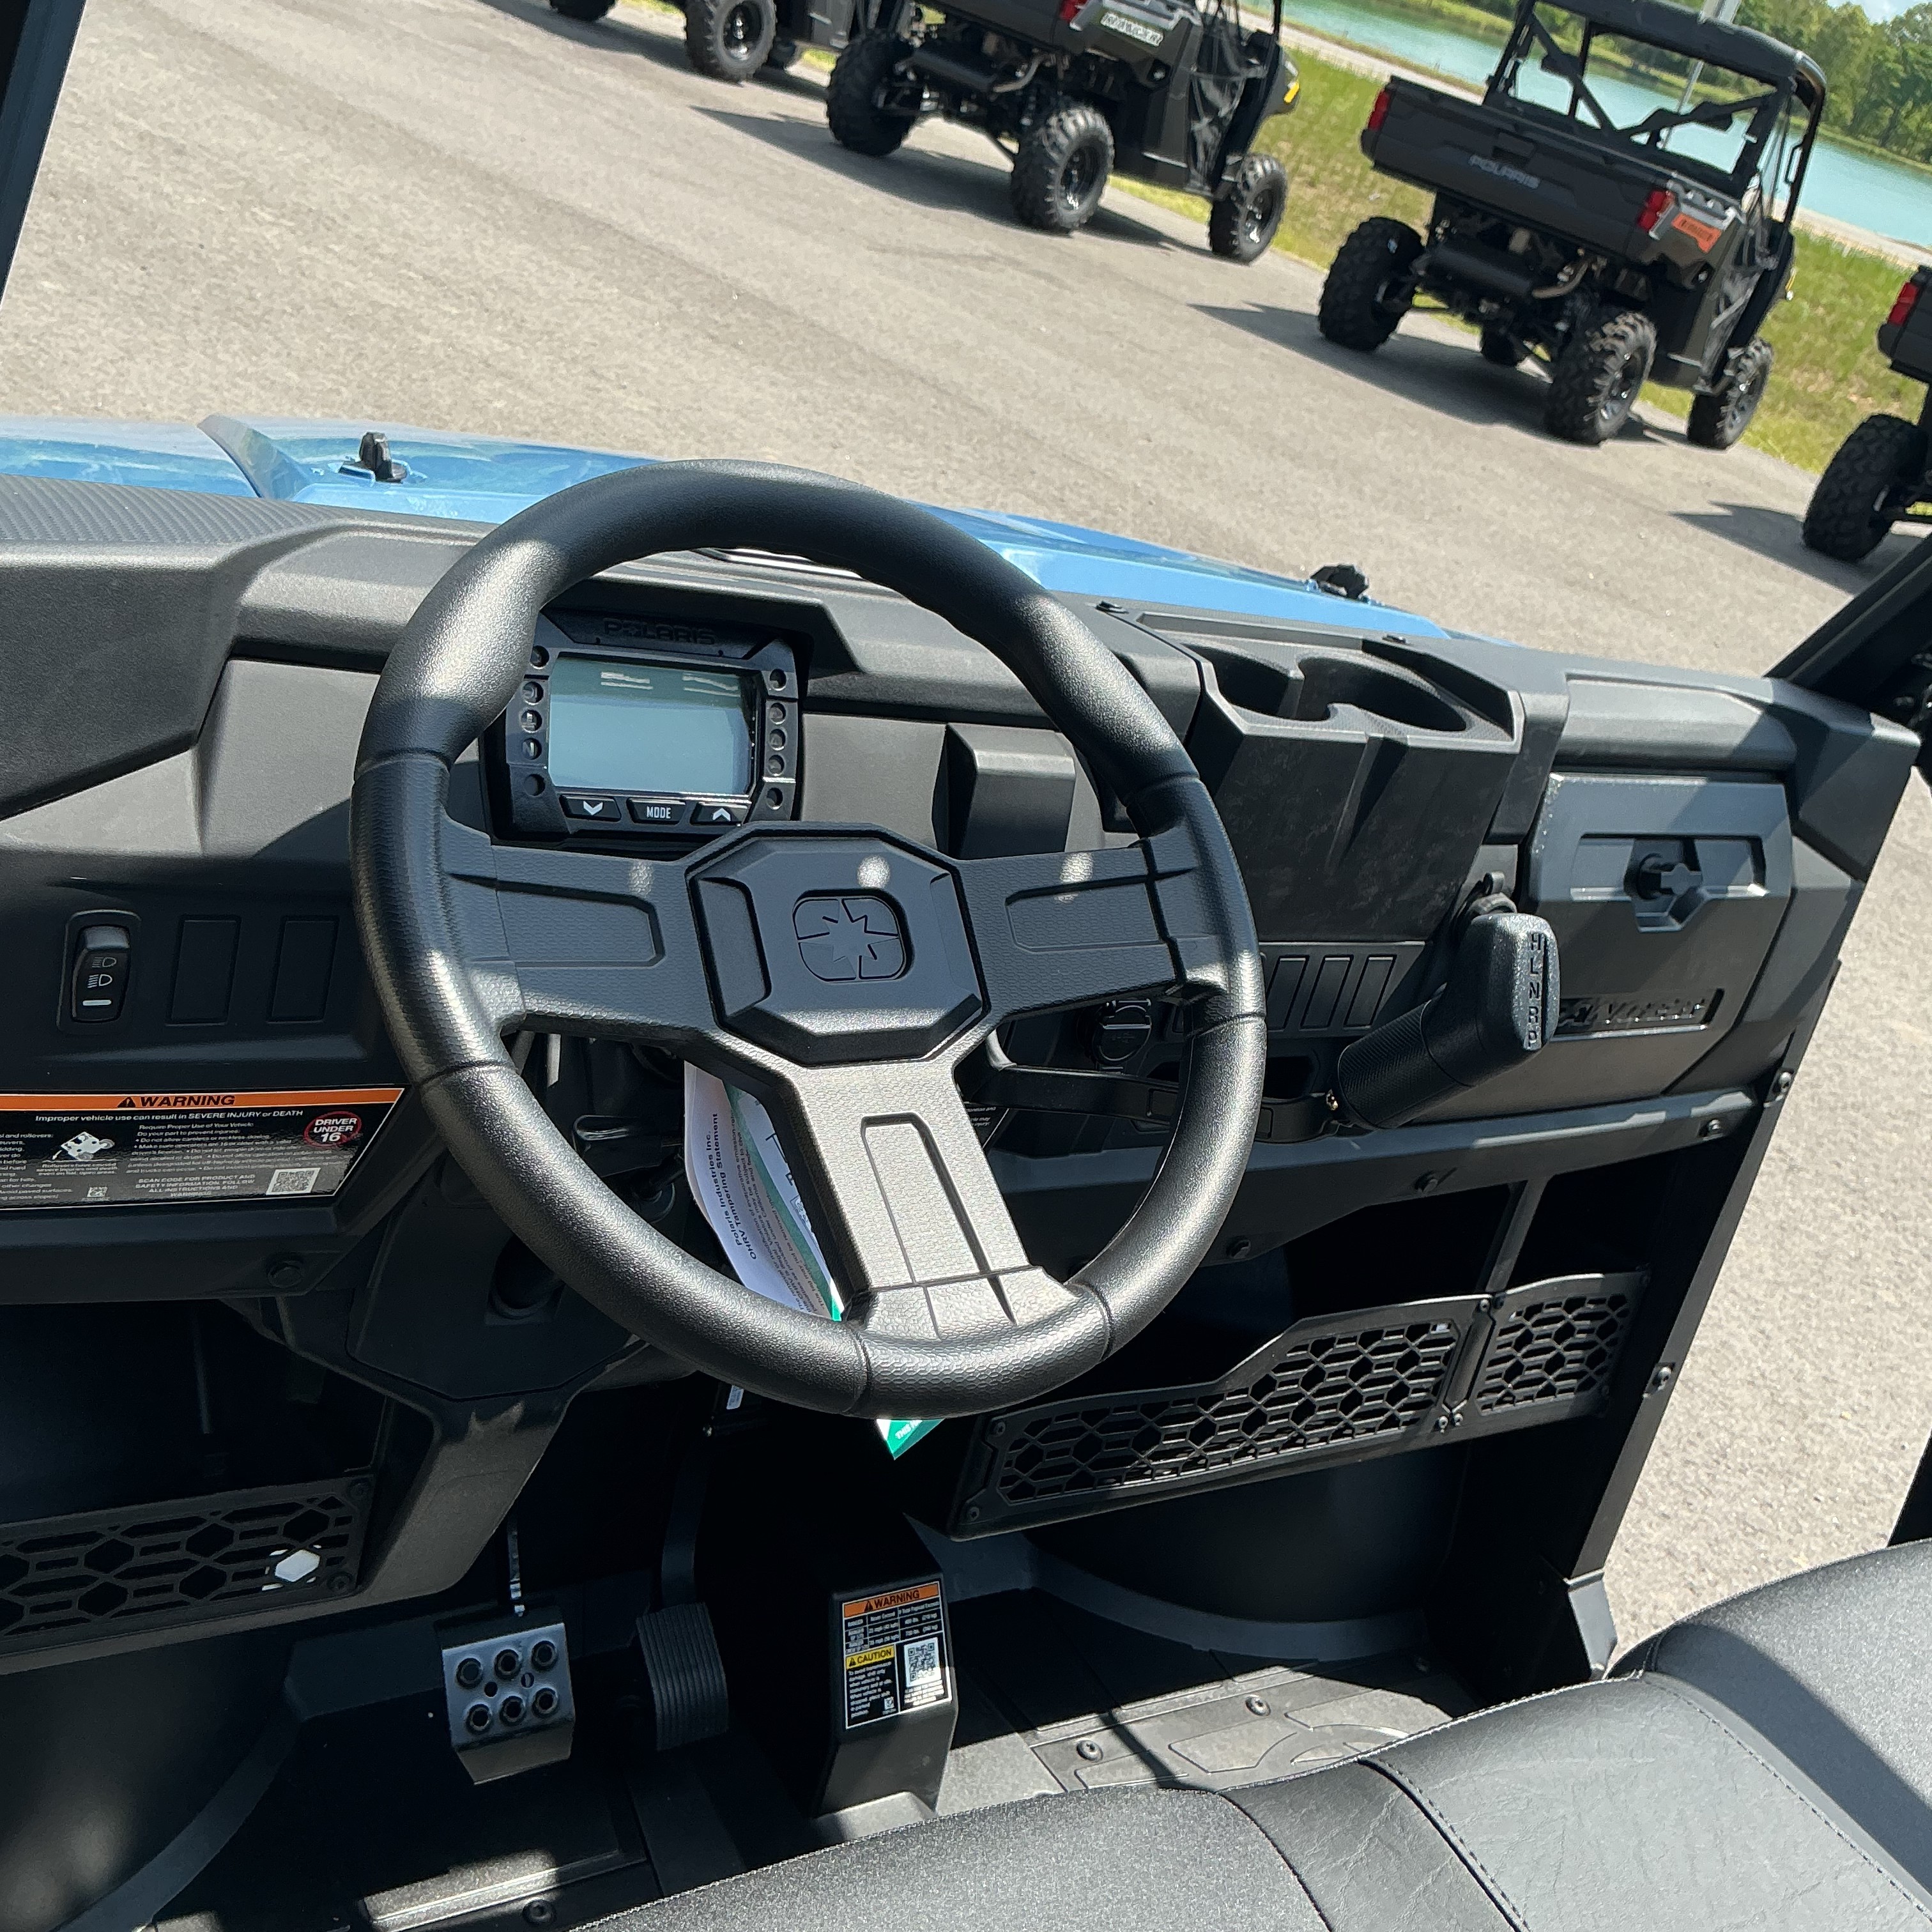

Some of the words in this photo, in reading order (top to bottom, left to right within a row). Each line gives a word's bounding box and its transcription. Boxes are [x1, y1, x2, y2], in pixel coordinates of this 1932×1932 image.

[1469, 155, 1540, 189] POLARIS
[603, 618, 716, 645] POLARIS
[646, 805, 671, 820] MODE
[140, 1095, 235, 1107] WARNING
[313, 1125, 353, 1133] UNDER
[321, 1132, 342, 1142] 16
[712, 1114, 723, 1168] Statement
[708, 1154, 726, 1207] Industries
[742, 1158, 751, 1185] subject
[720, 1172, 740, 1226] Tampering
[737, 1165, 754, 1208] evaporative
[748, 1187, 753, 1195] be
[753, 1184, 767, 1217] California
[724, 1211, 742, 1246] Polaris
[758, 1215, 772, 1245] Violators
[767, 1220, 776, 1239] under
[739, 1231, 756, 1259] OHRV
[894, 1423, 912, 1439] THIS
[873, 1590, 920, 1609] WARNING
[857, 1648, 892, 1664] CAUTION
